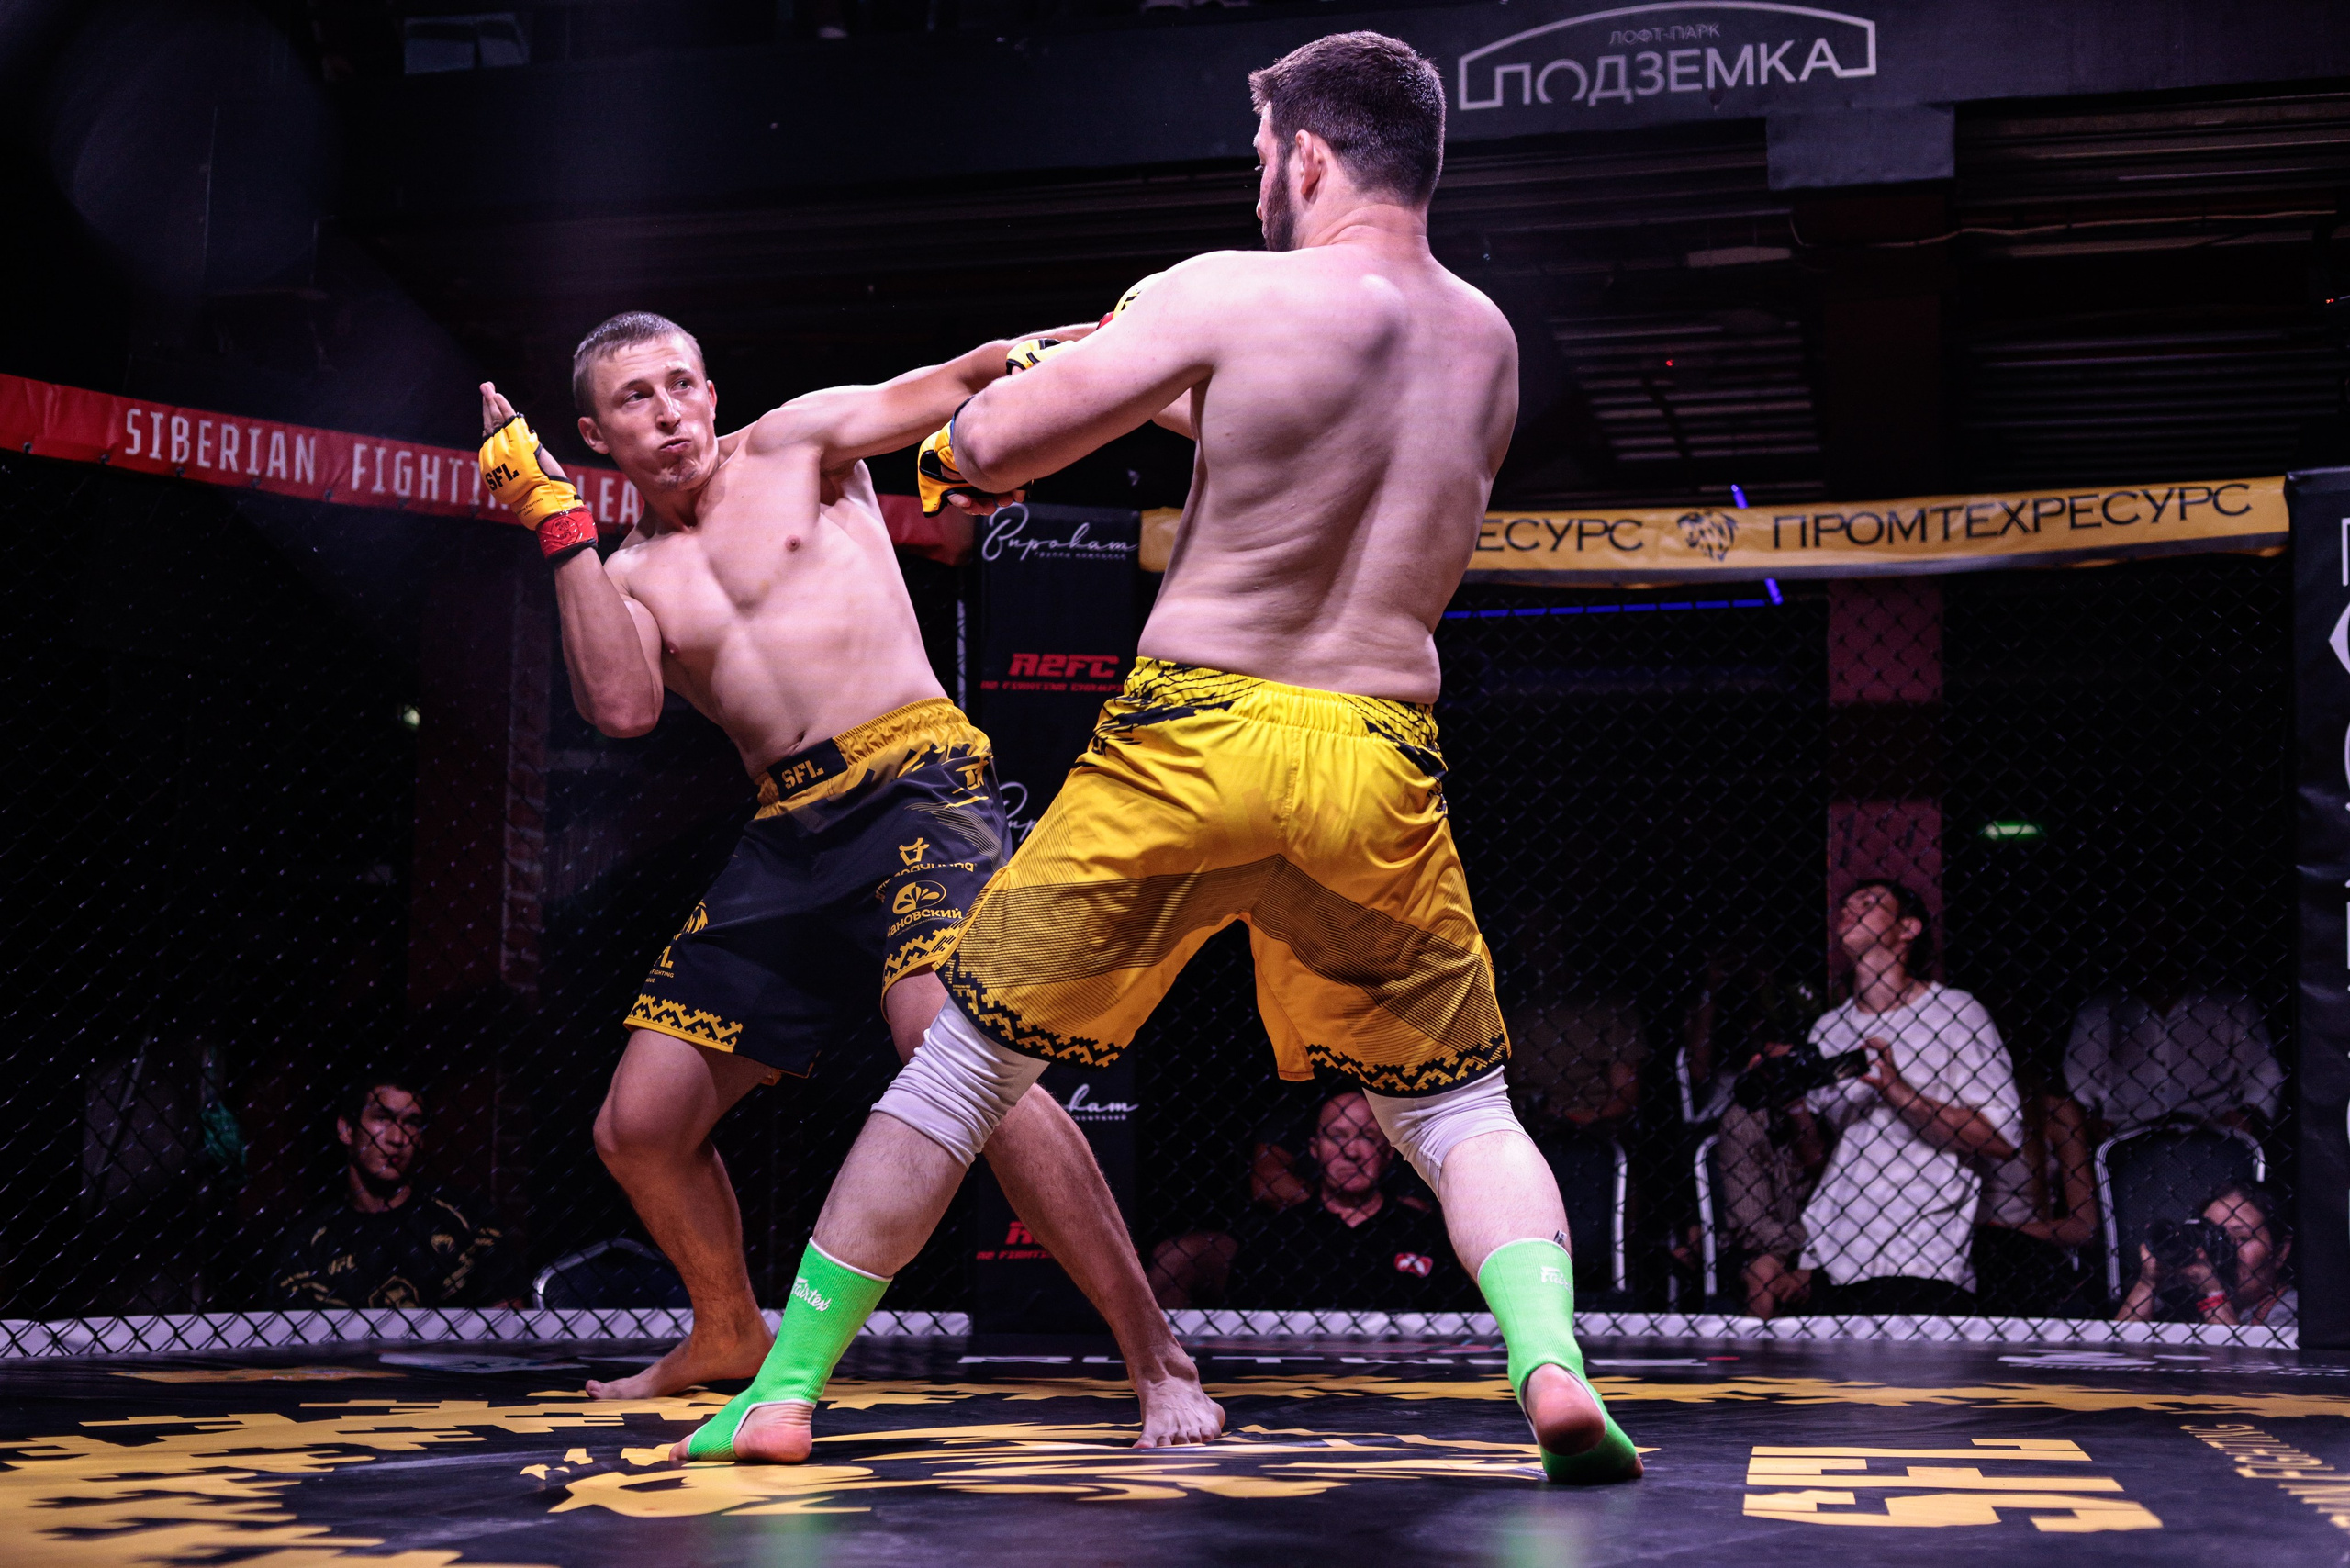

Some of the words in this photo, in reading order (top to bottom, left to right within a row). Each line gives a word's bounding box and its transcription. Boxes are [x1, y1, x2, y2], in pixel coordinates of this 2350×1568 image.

[1609, 23, 1720, 45] ЛОФТ-ПАРК
[1494, 37, 1841, 107] ПОДЗЕМКА
[125, 408, 317, 485] SIBERIAN
[352, 444, 510, 511] FIGHTI
[576, 474, 644, 525] LEA
[485, 463, 520, 491] SFL
[1773, 482, 2252, 549] ПРОМТЕХРЕСУРС
[781, 759, 825, 790] SFL
[790, 1276, 832, 1312] Fairtex
